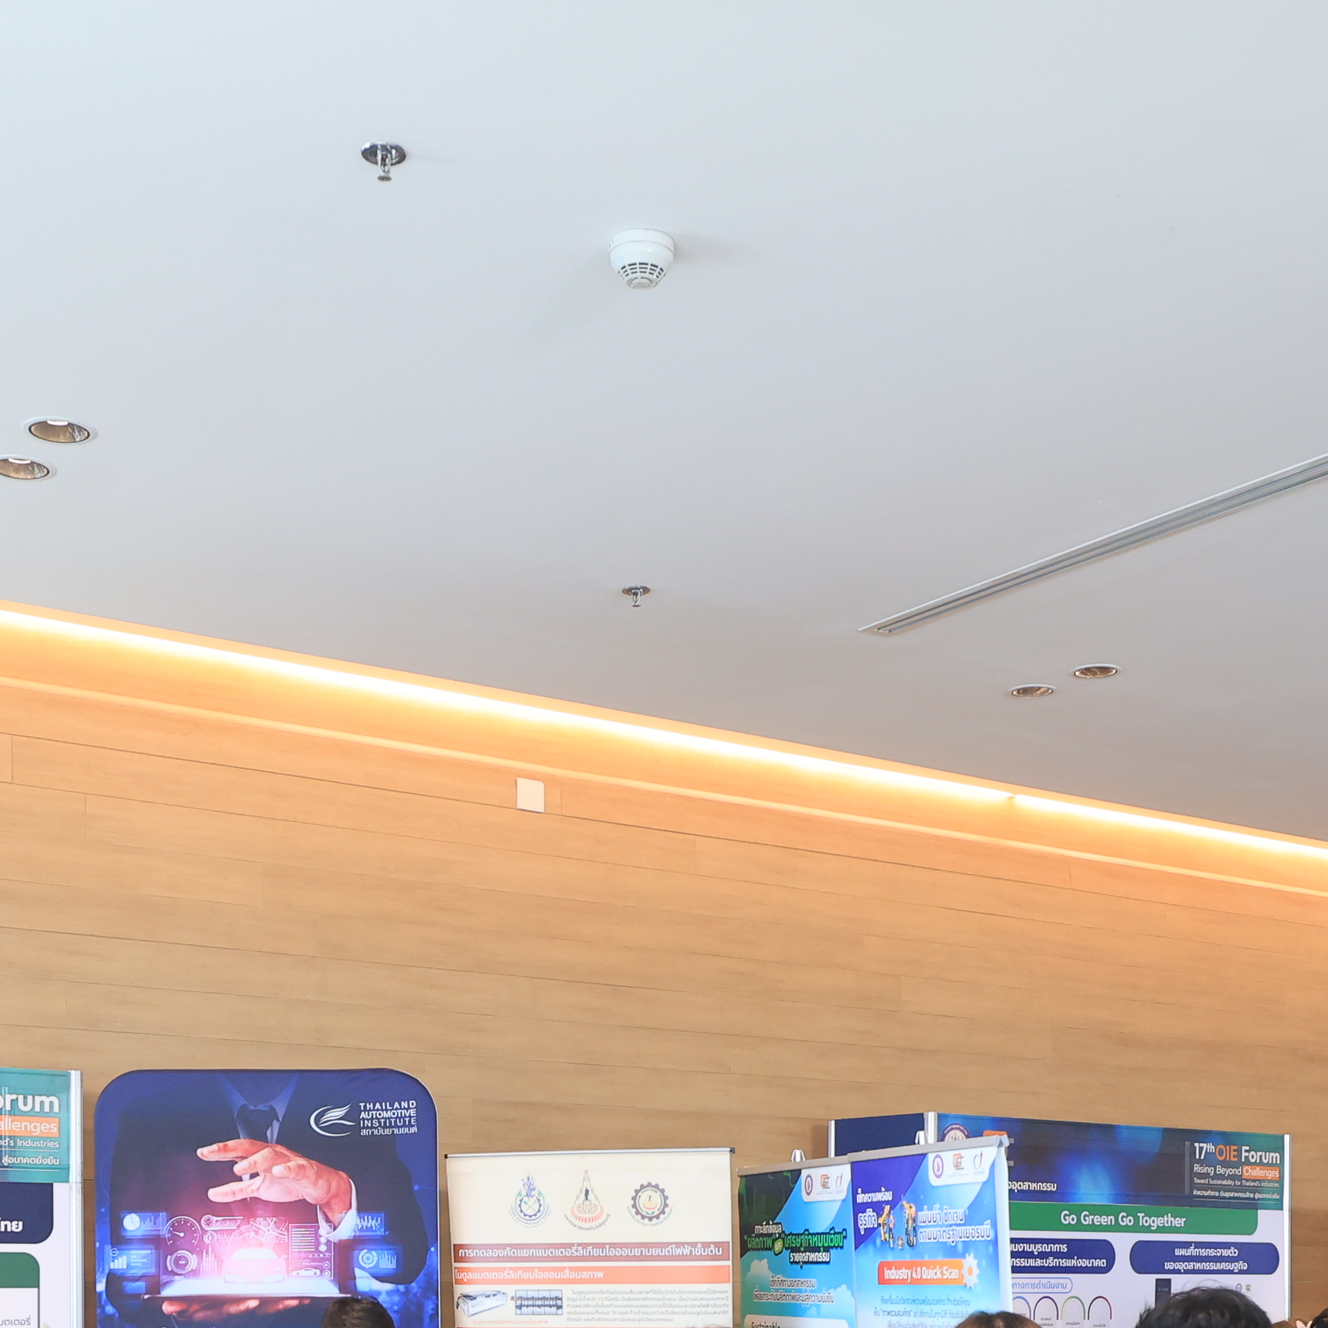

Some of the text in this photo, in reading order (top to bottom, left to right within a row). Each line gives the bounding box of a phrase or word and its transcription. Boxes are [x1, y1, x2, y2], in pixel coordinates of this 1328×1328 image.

[359, 1100, 417, 1110] THAILAND
[360, 1109, 417, 1119] AUTOMOTIVE
[360, 1117, 417, 1127] INSTITUTE
[17, 1138, 60, 1148] Industries
[1194, 1142, 1280, 1164] 17th OIE Forum
[1193, 1163, 1280, 1179] Rising Beyond Challenges
[1060, 1211, 1186, 1230] Go Green Go Together
[884, 1265, 960, 1283] Industry 4.0 Quick Scan
